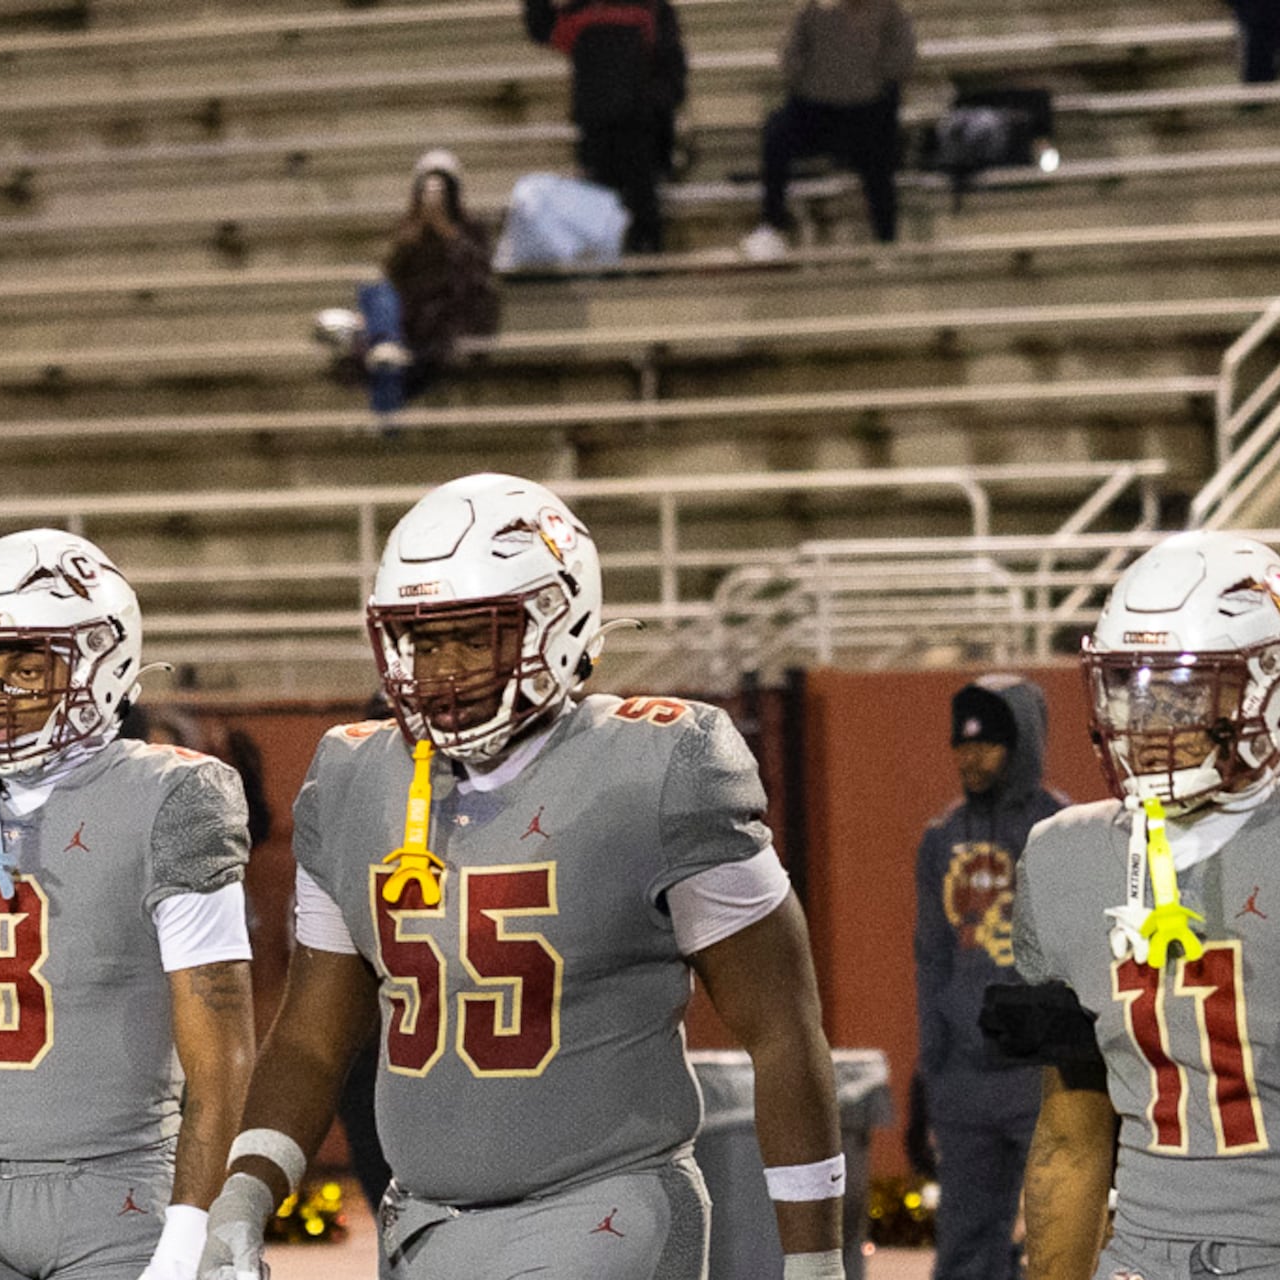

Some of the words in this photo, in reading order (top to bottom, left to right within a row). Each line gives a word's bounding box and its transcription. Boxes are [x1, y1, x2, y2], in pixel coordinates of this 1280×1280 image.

[70, 556, 97, 580] C
[369, 861, 564, 1078] 55
[1110, 939, 1269, 1156] 11
